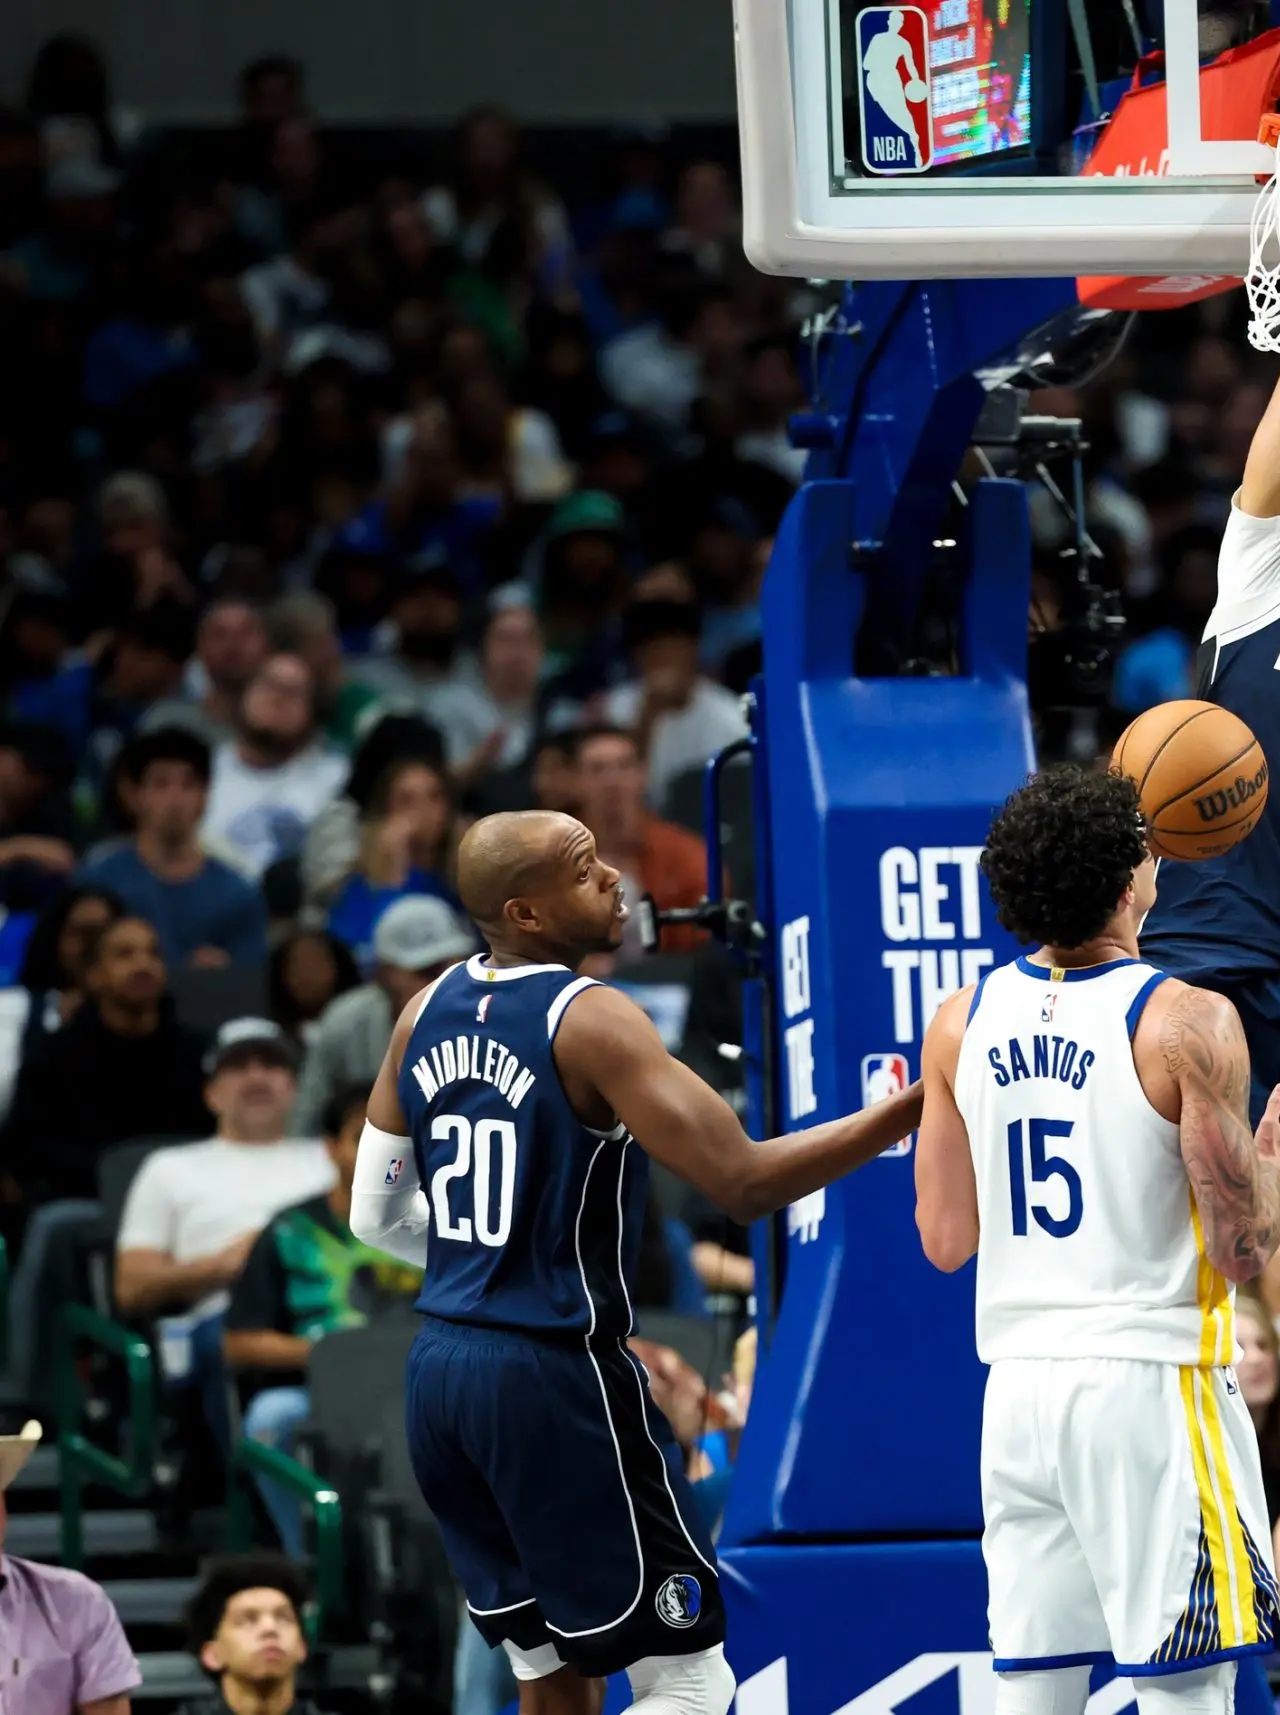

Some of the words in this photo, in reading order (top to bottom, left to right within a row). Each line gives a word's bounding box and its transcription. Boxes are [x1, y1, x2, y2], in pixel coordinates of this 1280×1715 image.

[873, 136, 907, 162] NBA
[1194, 760, 1268, 822] Wilson
[879, 846, 985, 942] GET
[782, 915, 811, 1018] GET
[411, 1035, 537, 1110] MIDDLETON
[785, 1018, 817, 1120] THE
[988, 1035, 1095, 1090] SANTOS
[431, 1114, 517, 1247] 20
[1007, 1118, 1084, 1238] 15
